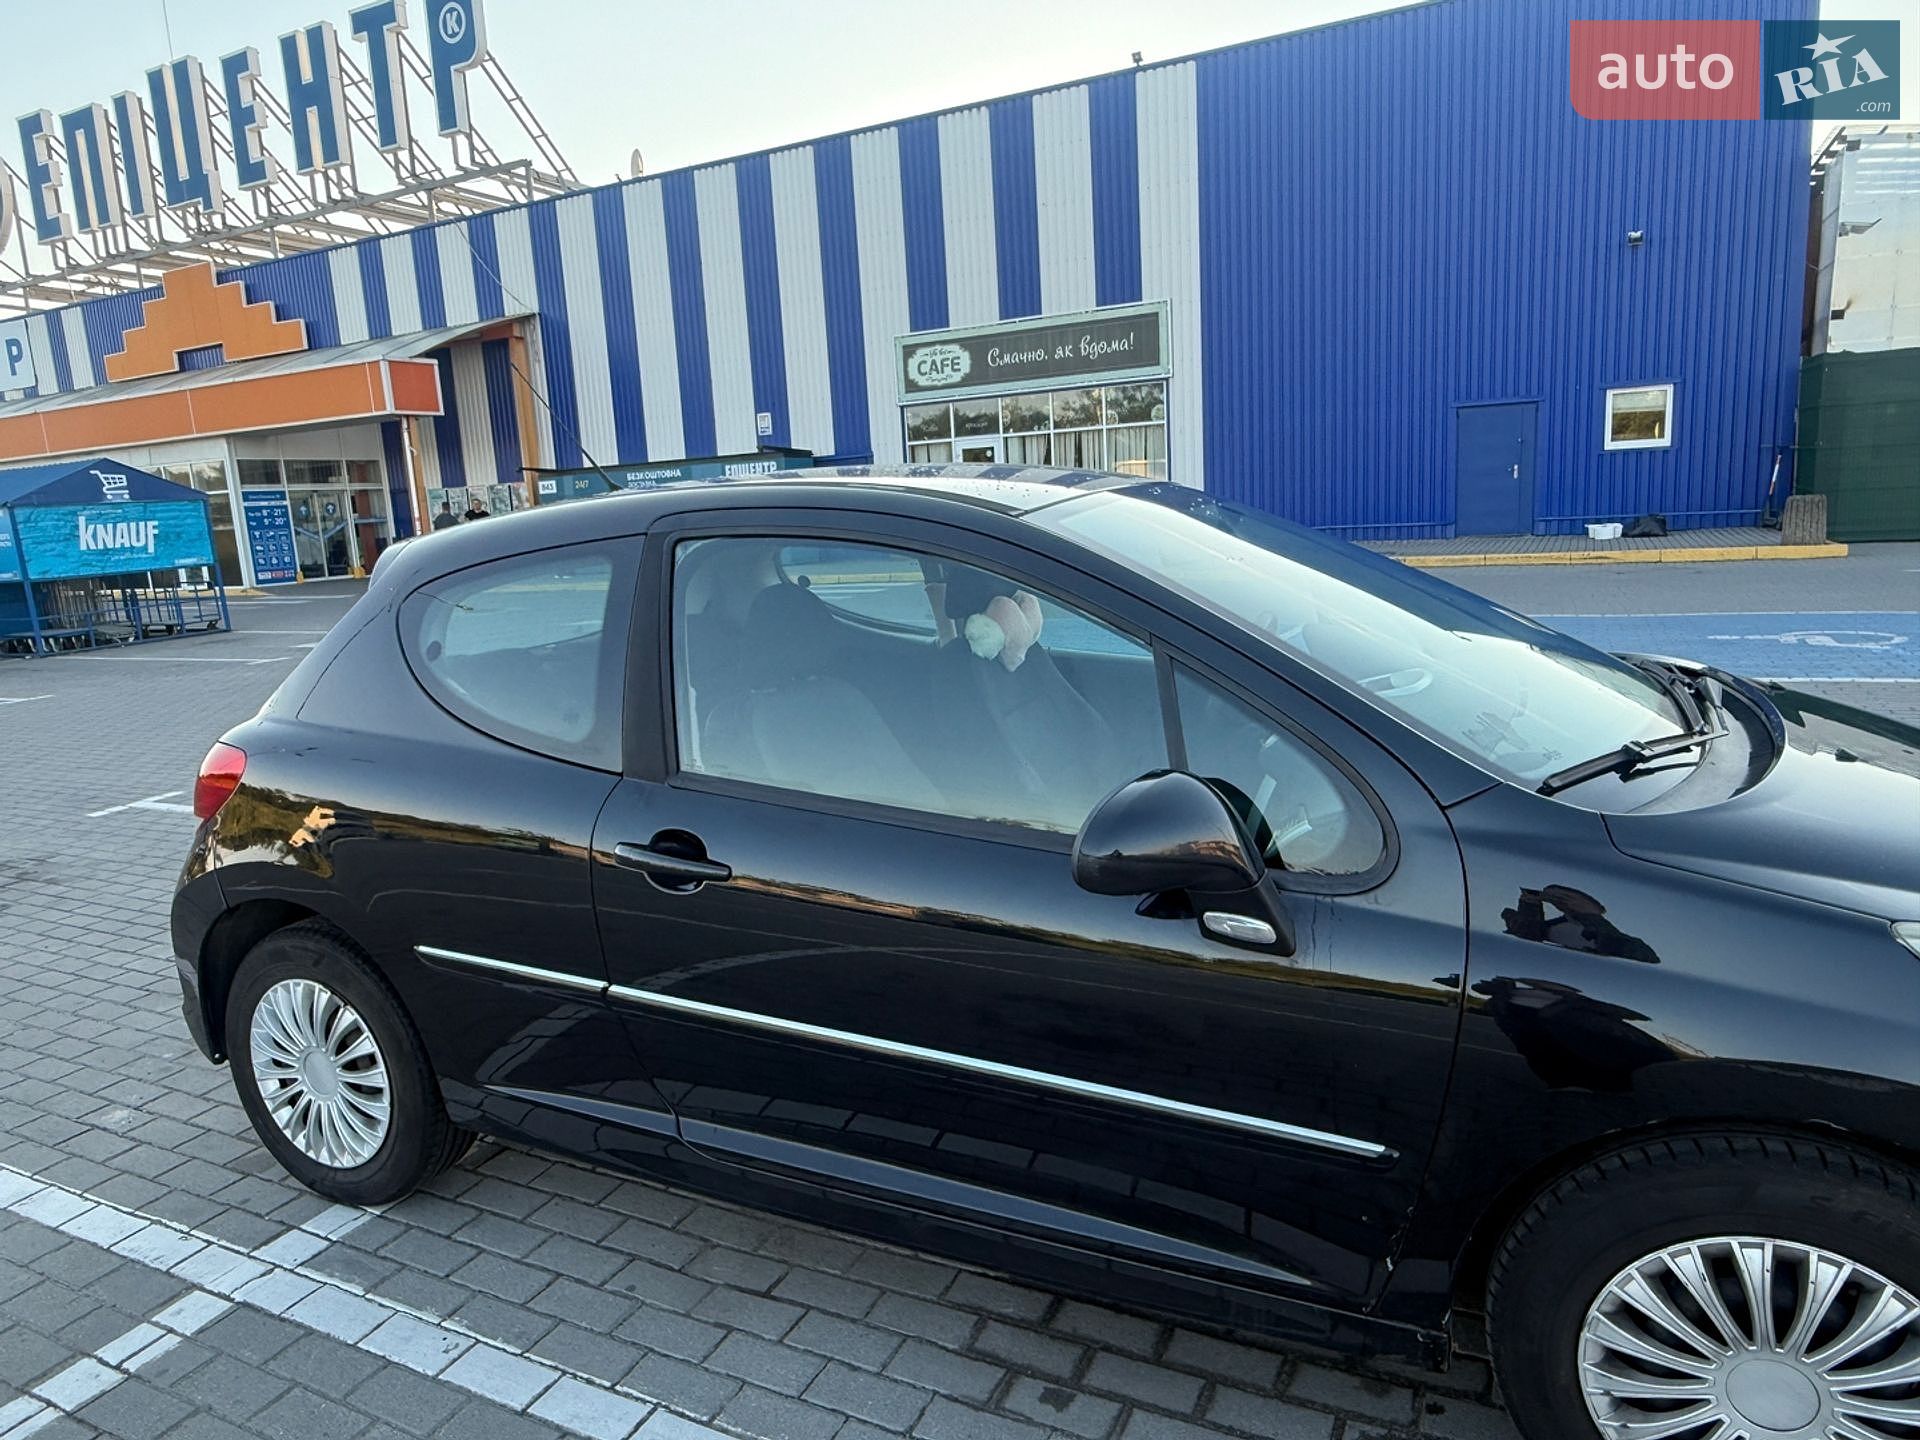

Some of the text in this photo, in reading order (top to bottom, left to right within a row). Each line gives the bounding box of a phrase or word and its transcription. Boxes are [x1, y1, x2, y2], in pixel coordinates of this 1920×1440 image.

[16, 0, 487, 246] ЕПІЦЕНТР
[1054, 345, 1074, 360] як
[1079, 332, 1134, 359] вдома!
[917, 356, 961, 376] CAFE
[78, 516, 159, 553] KNAUF
